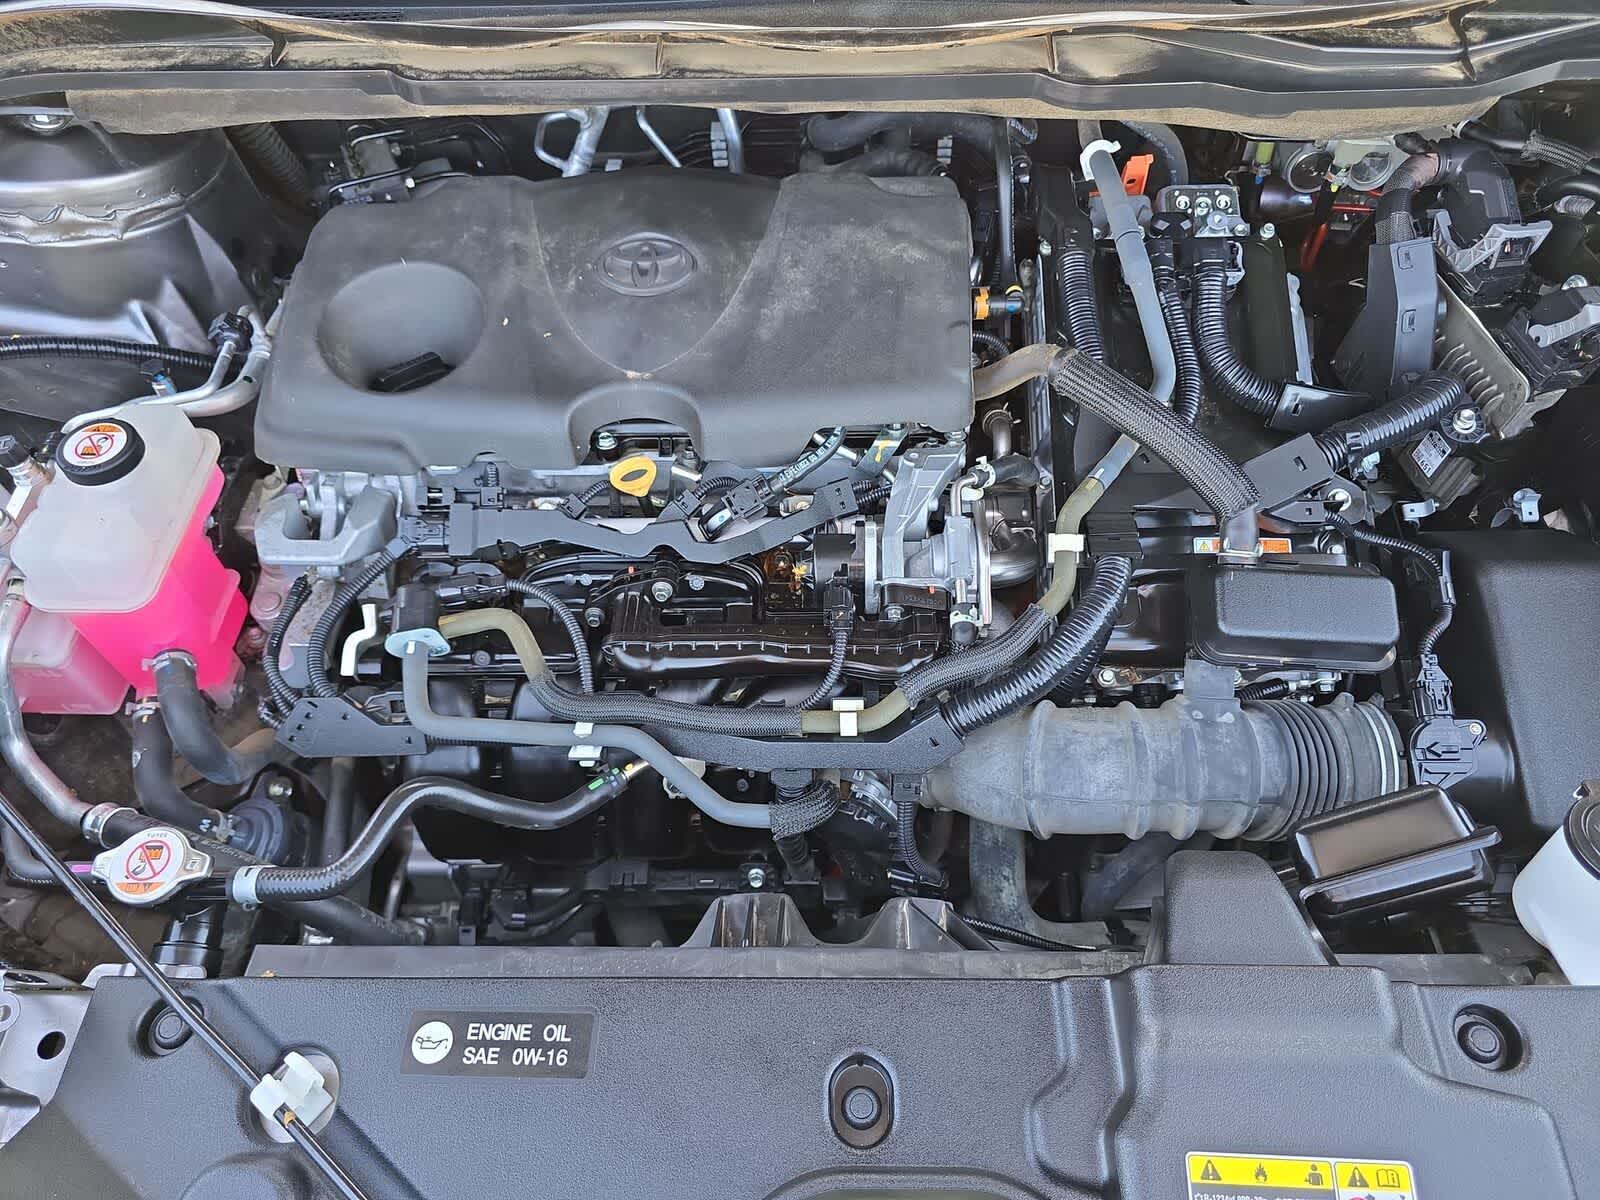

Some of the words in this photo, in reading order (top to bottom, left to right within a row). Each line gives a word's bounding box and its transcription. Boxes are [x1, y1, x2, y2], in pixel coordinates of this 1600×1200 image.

[466, 1023, 532, 1042] ENGINE
[542, 1024, 572, 1042] OIL
[462, 1047, 500, 1065] SAE
[512, 1048, 568, 1066] 0W-16
